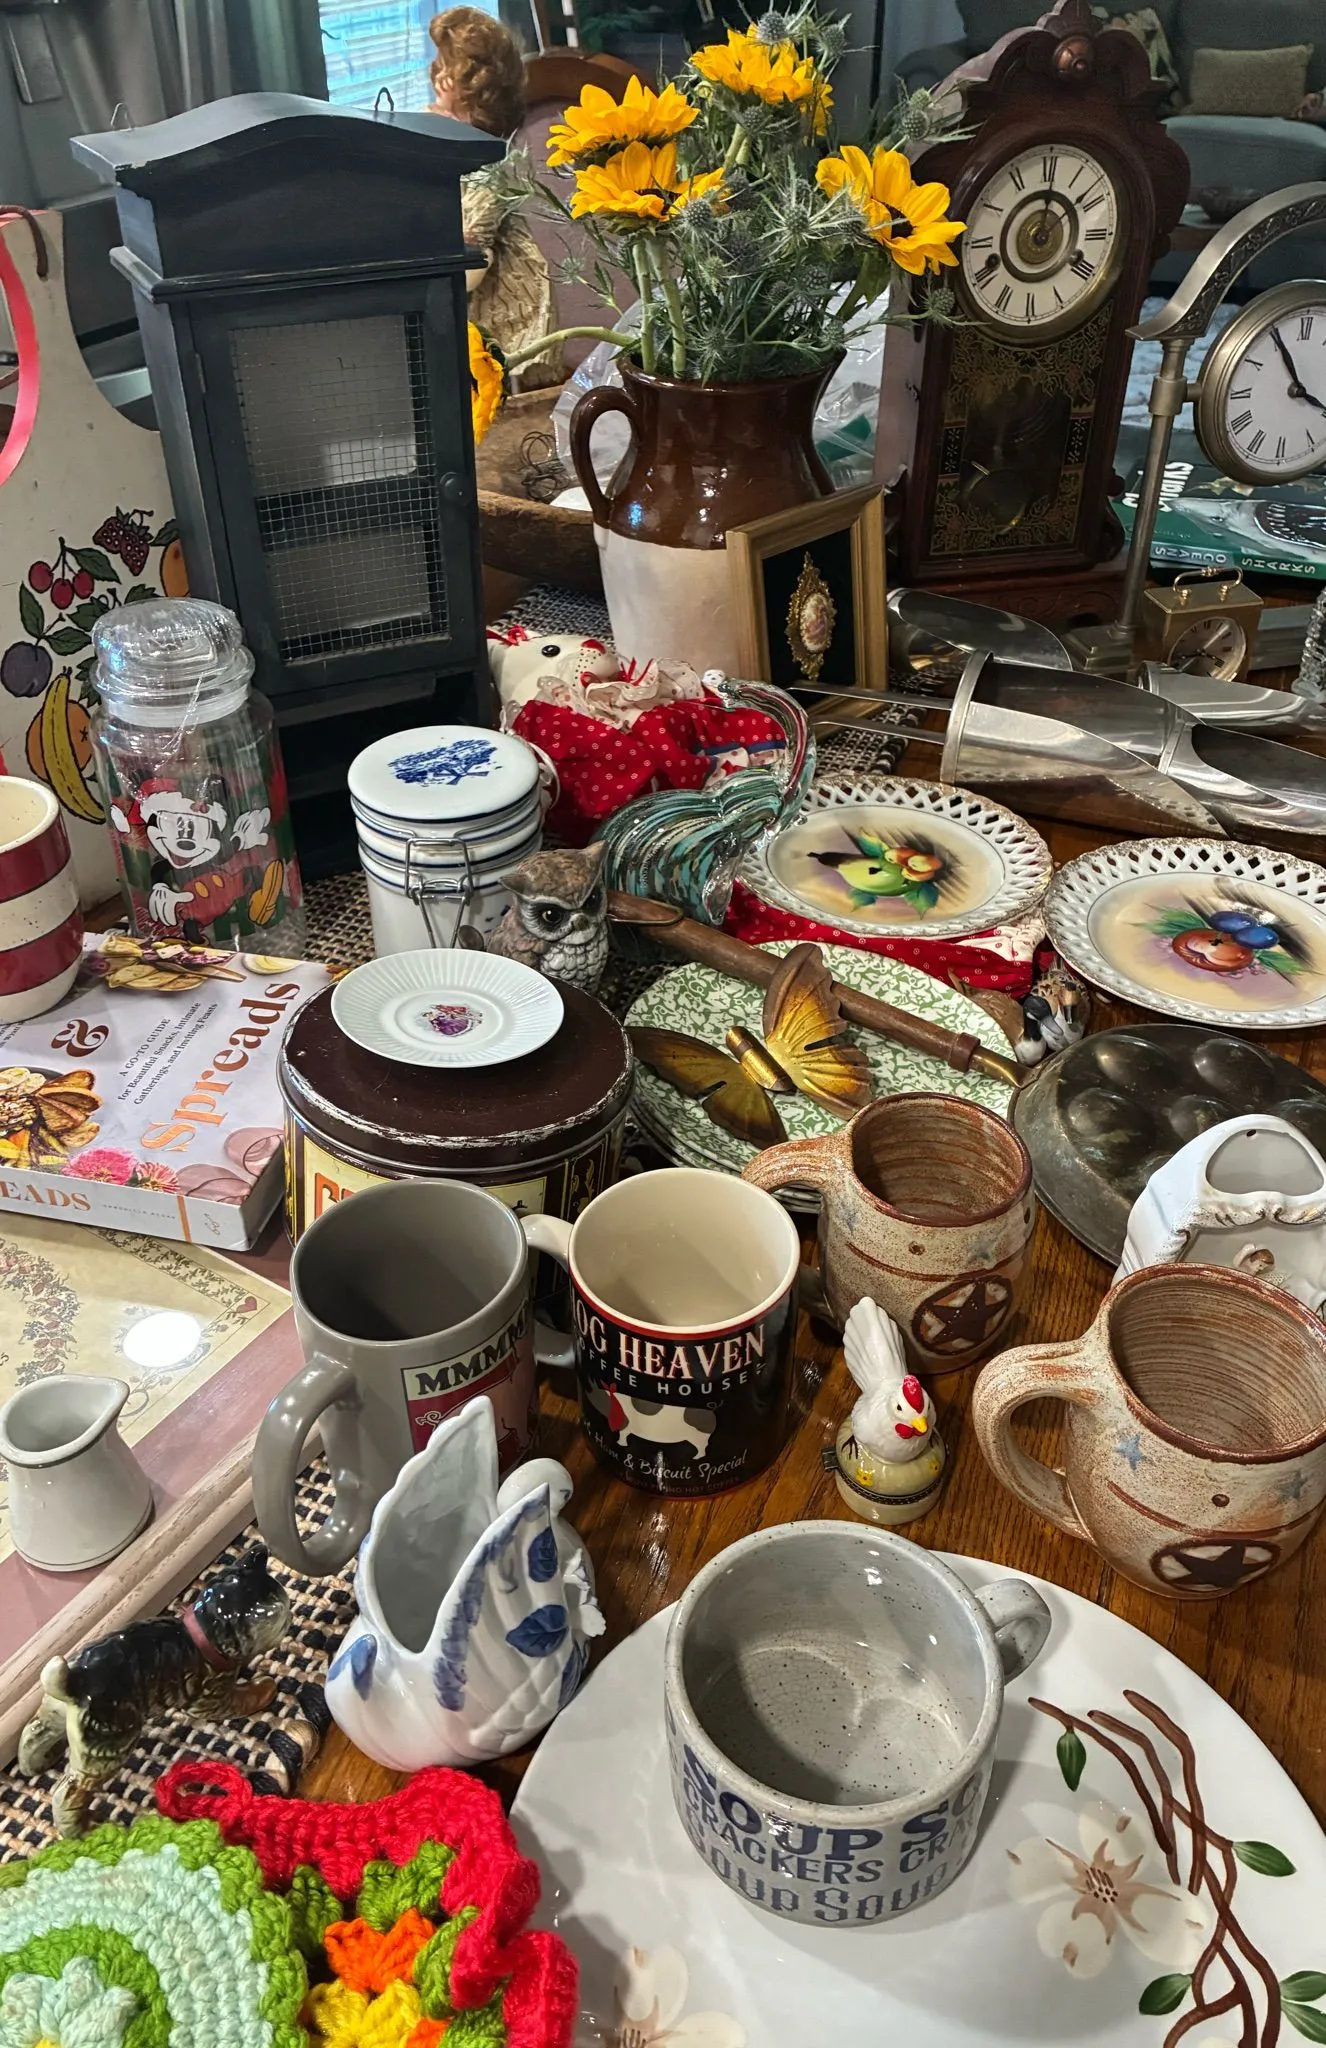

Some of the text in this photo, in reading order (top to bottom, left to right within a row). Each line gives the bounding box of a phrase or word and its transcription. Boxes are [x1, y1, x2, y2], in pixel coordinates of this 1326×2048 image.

[1084, 228, 1107, 241] III
[1154, 546, 1227, 564] OCEANS
[1242, 557, 1316, 575] SHARKS
[51, 1018, 110, 1058] &
[125, 1044, 150, 1069] GO-TO
[147, 1018, 171, 1043] GUIDE
[127, 1056, 158, 1088] Beautiful
[154, 1031, 180, 1056] Snacks,
[175, 1002, 201, 1030] Intimate
[133, 1003, 218, 1105] Gatherings, and Inviting Feasts
[140, 983, 301, 1152] Spreads
[572, 1294, 766, 1380] OG HEAVEN
[575, 1326, 749, 1396] OFFEE HOUSE
[623, 1453, 635, 1471] &
[639, 1457, 692, 1481] Biscuit
[698, 1448, 749, 1484] Special
[683, 1743, 884, 1861] SOUP
[683, 1776, 884, 1885] CRACKERS
[813, 1862, 948, 1923] SOUP
